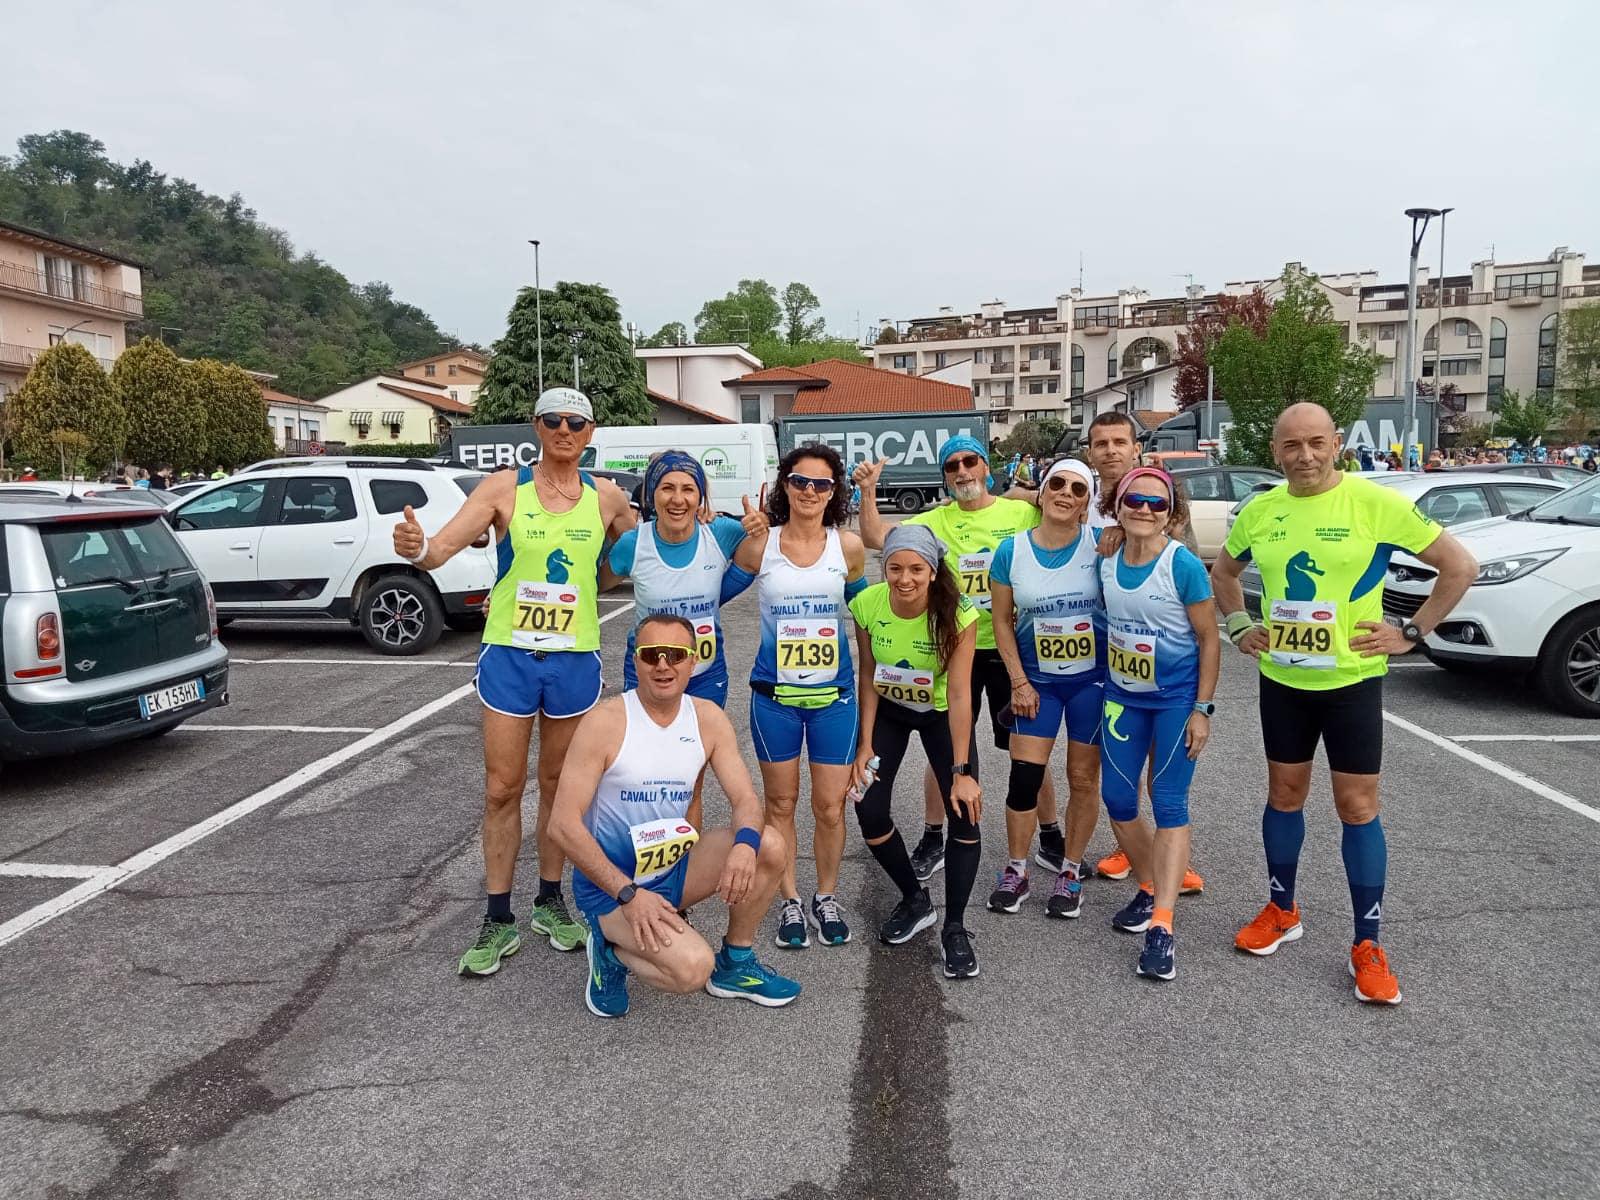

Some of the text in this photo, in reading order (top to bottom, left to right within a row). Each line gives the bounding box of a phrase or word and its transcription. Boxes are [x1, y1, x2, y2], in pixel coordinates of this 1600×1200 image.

[459, 442, 543, 469] FERC
[518, 604, 575, 631] 7017
[699, 640, 712, 660] 0
[1039, 637, 1091, 659] 8209
[1272, 625, 1330, 652] 7449
[780, 643, 835, 666] 7139
[1110, 647, 1151, 680] 7140
[147, 682, 198, 712] EK 153HX
[877, 685, 930, 703] 7019
[620, 790, 657, 802] CAVALLI
